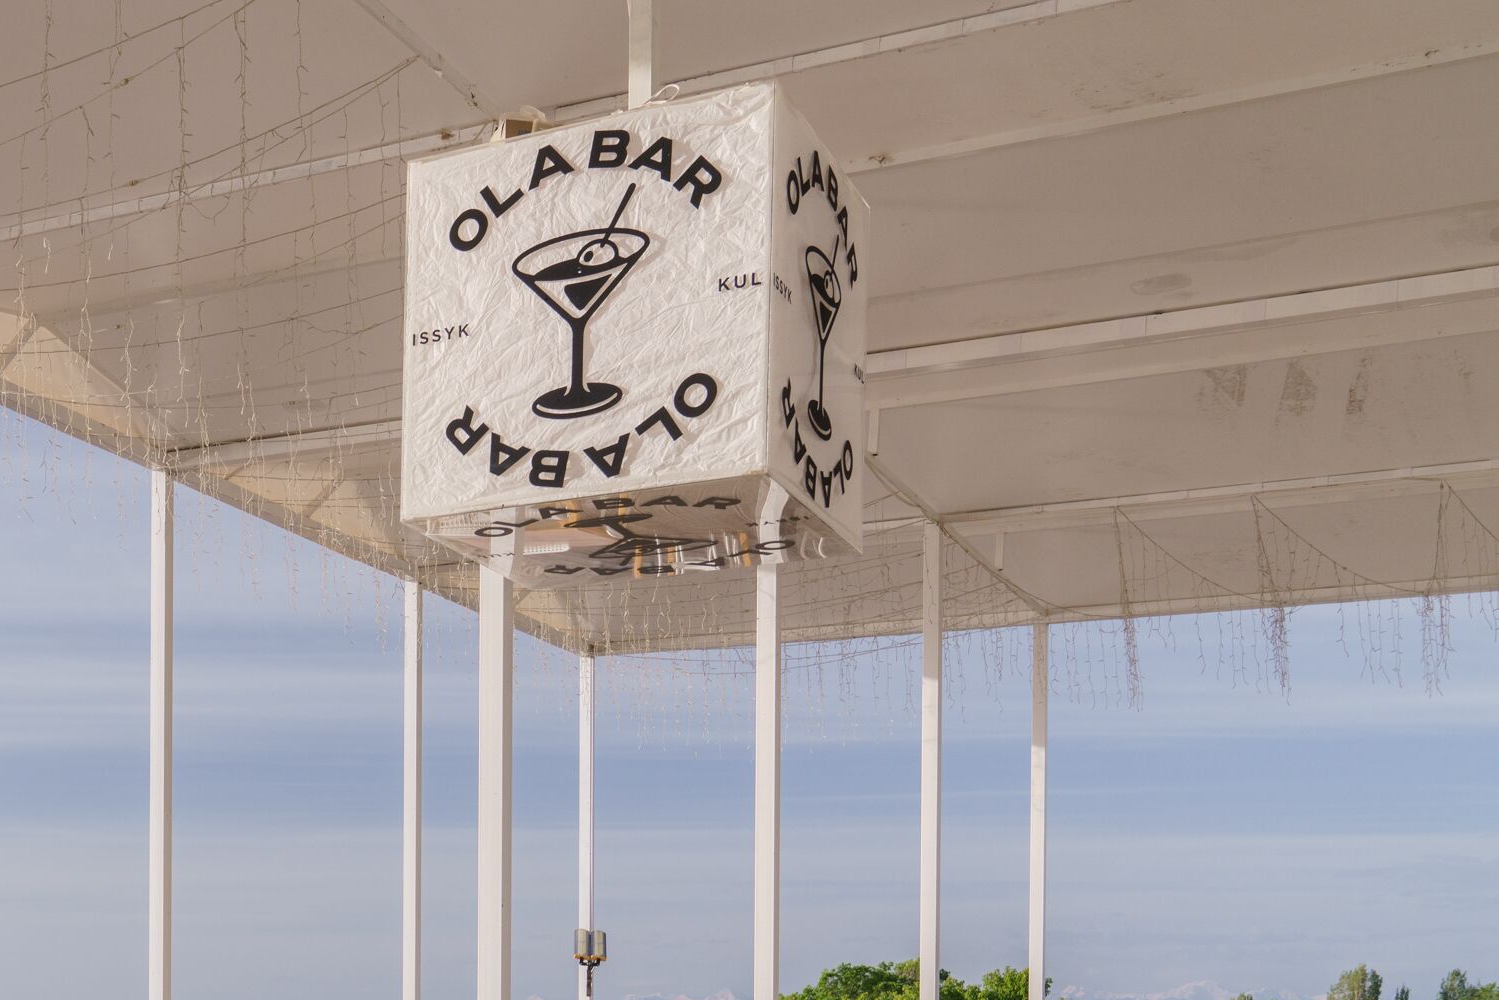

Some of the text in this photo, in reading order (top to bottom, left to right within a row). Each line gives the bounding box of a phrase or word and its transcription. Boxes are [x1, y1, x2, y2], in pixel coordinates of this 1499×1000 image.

[718, 273, 762, 292] KUL
[773, 273, 792, 304] ISSYK
[412, 324, 469, 346] ISSYK
